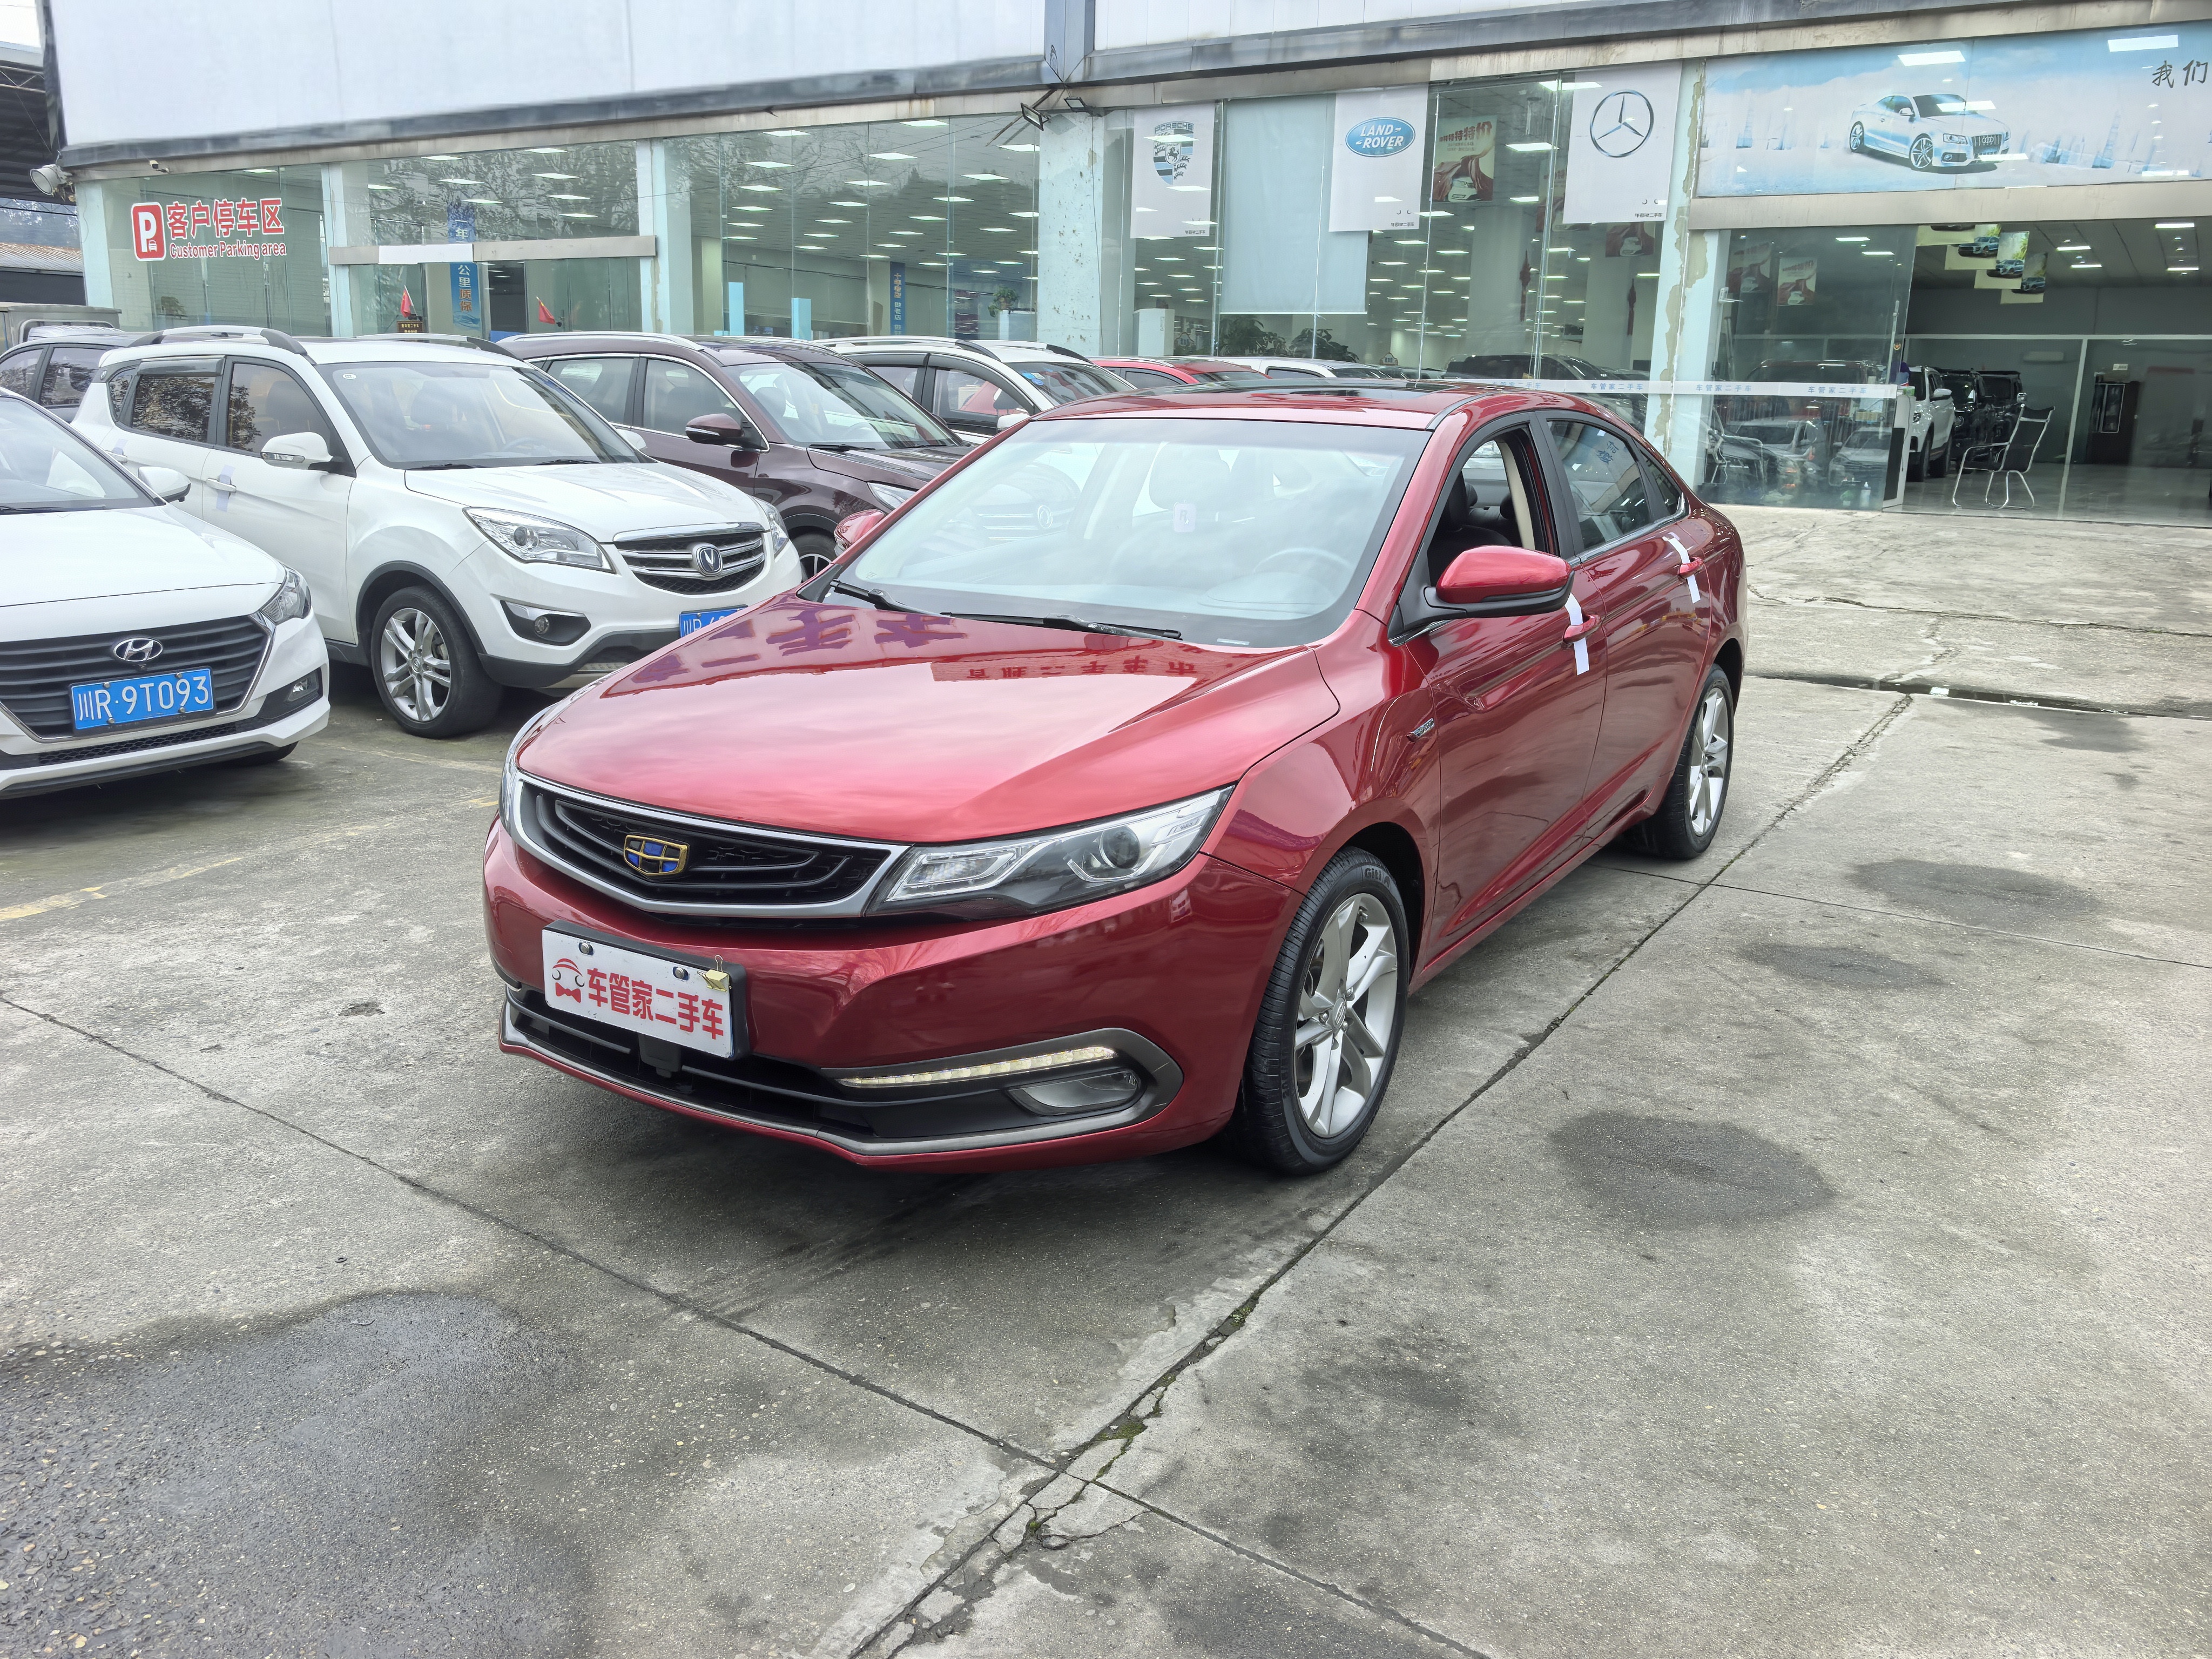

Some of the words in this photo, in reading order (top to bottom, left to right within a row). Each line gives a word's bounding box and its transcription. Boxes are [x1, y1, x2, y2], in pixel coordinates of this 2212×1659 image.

[2152, 59, 2208, 89] 我们
[1155, 122, 1194, 133] PORSCHE
[1360, 124, 1394, 137] LAND
[1362, 136, 1404, 149] ROVER
[166, 198, 285, 240] 客户停车区
[138, 212, 157, 252] P
[169, 242, 218, 259] Customer
[219, 239, 259, 260] Parking
[262, 242, 286, 256] area
[458, 265, 472, 312] 公里质保
[1696, 384, 1752, 393] 车管家二手车
[1808, 386, 1867, 395] 车管家二手车
[587, 968, 724, 1040] 车管家二手车
